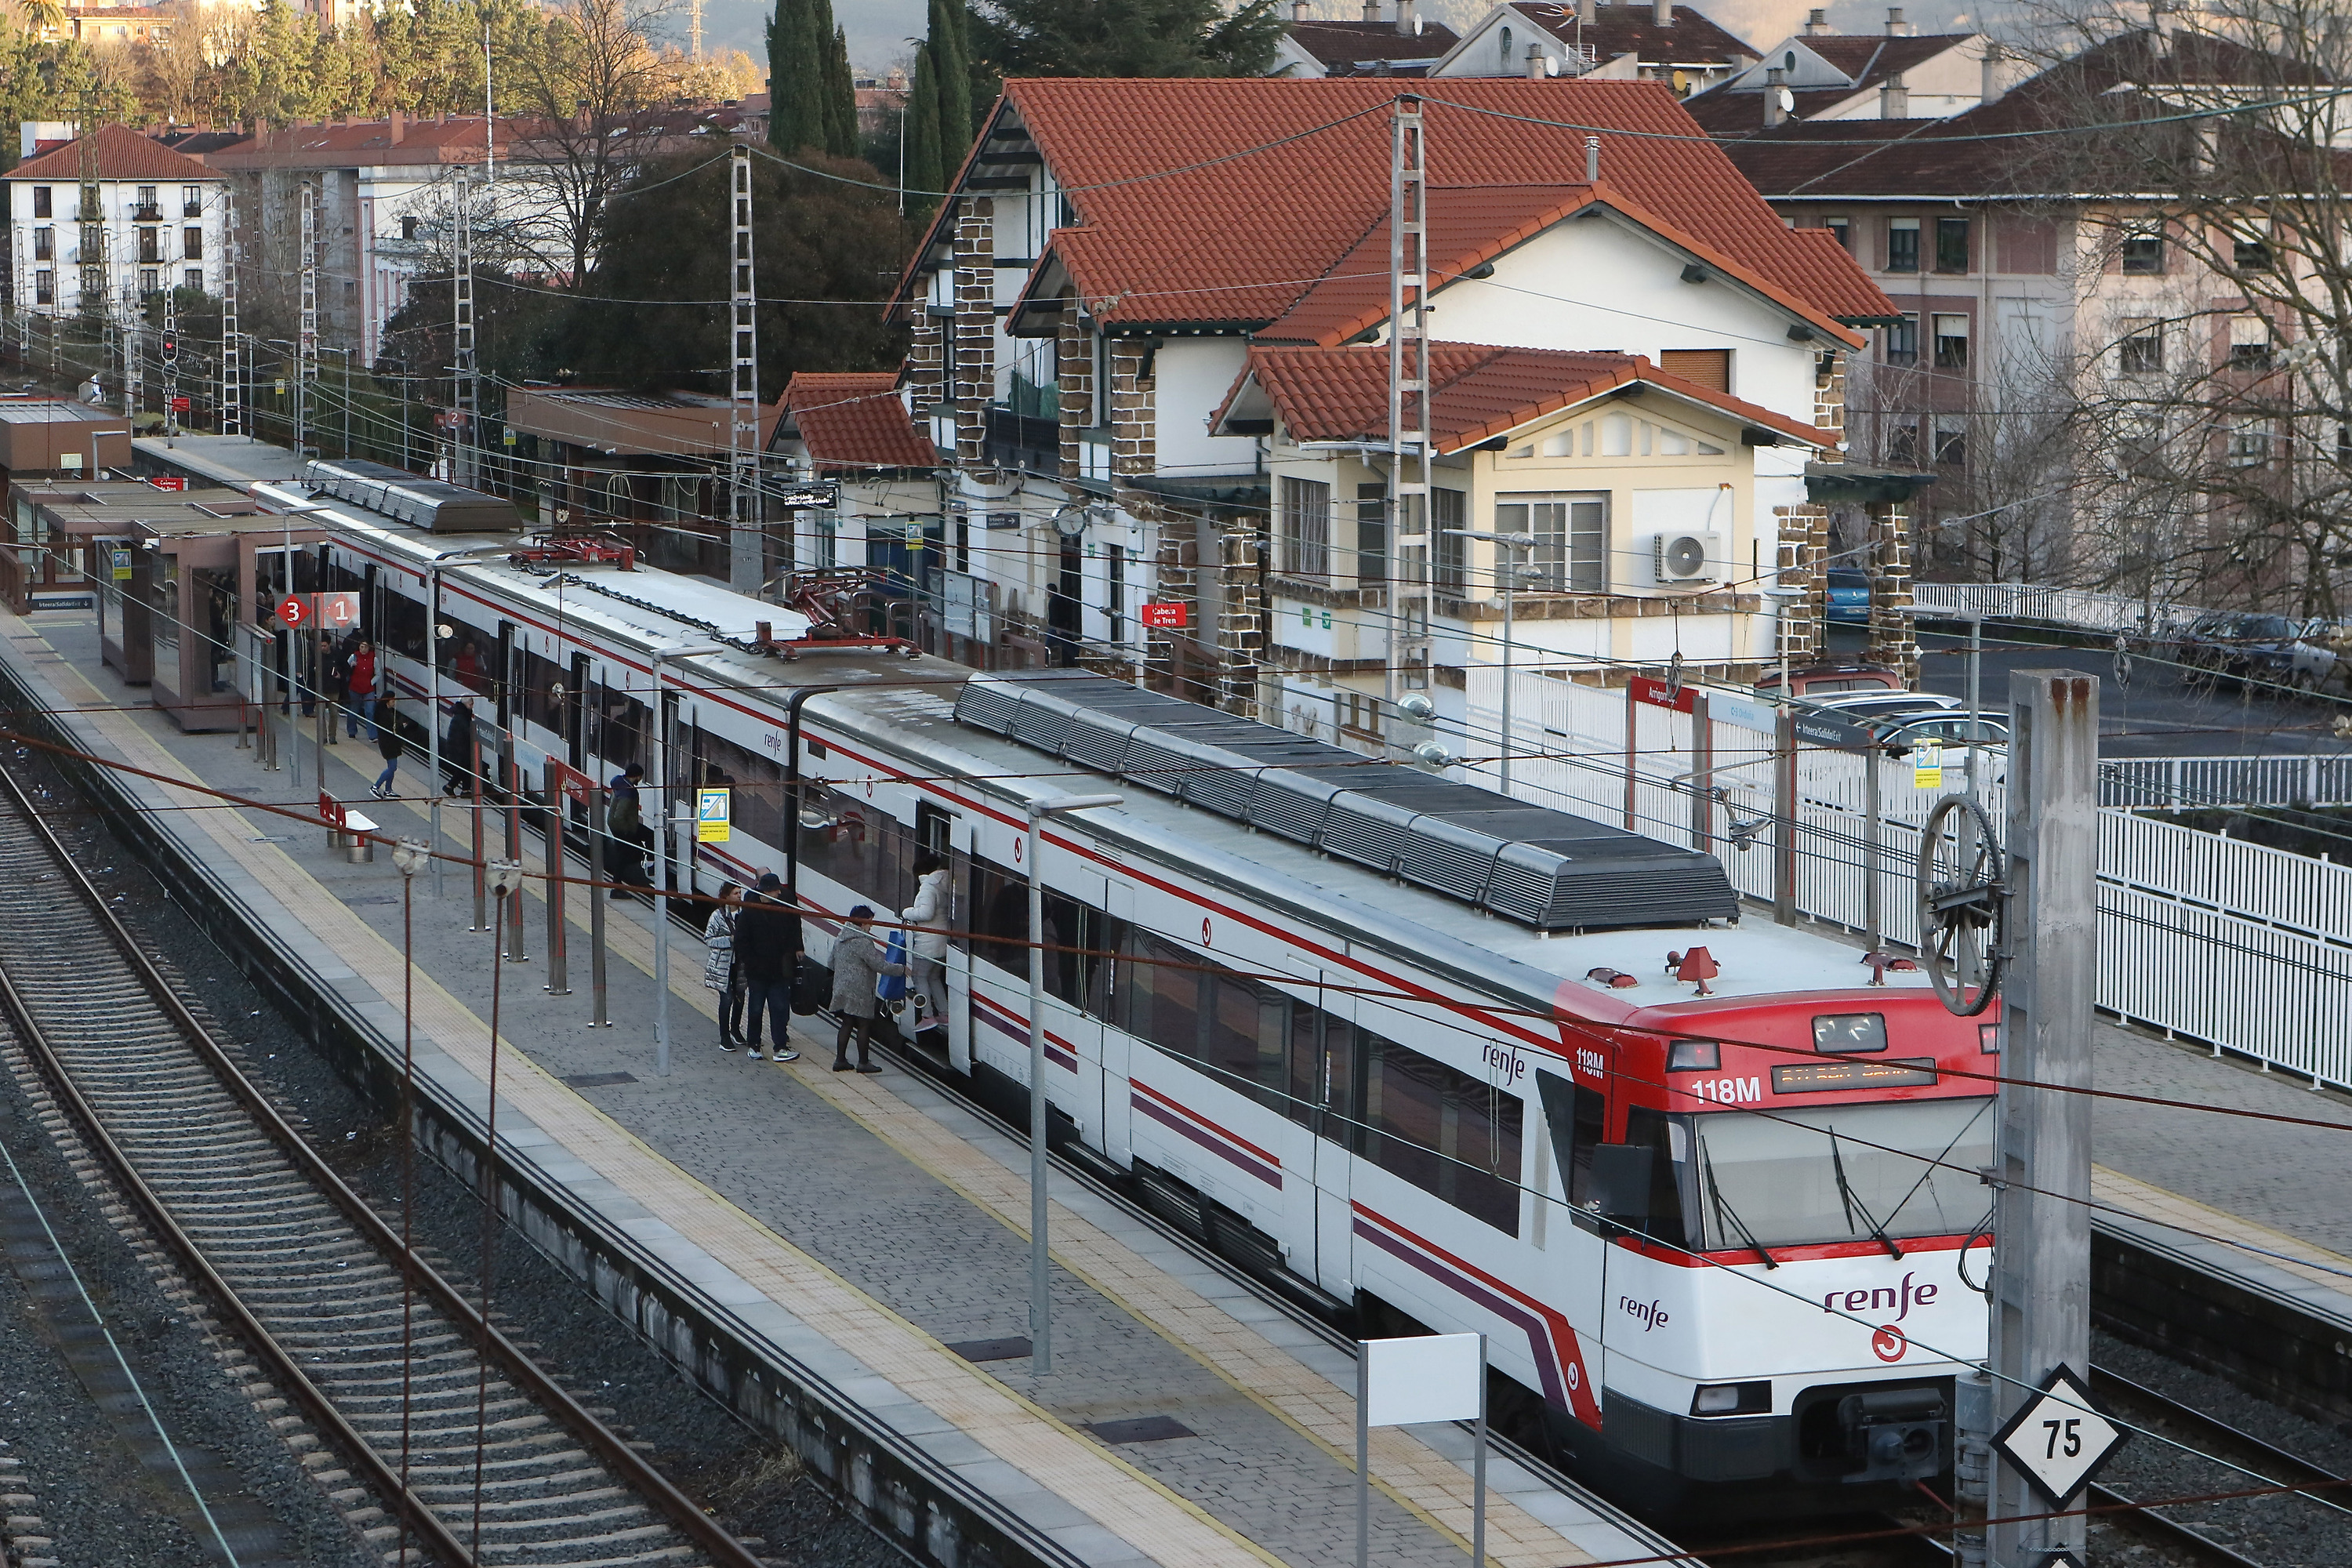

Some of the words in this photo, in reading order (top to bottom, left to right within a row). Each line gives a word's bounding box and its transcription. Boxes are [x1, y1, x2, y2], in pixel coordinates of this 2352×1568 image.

[451, 412, 459, 423] 2
[287, 601, 299, 622] 3
[335, 601, 348, 620] 1
[764, 730, 782, 757] renfe
[1483, 1044, 1526, 1087] renfe
[1576, 1047, 1604, 1080] 118M
[1691, 1076, 1762, 1105] 118M
[1824, 1271, 1938, 1322] renfe
[1619, 1295, 1669, 1332] renfe
[2042, 1417, 2082, 1460] 75
